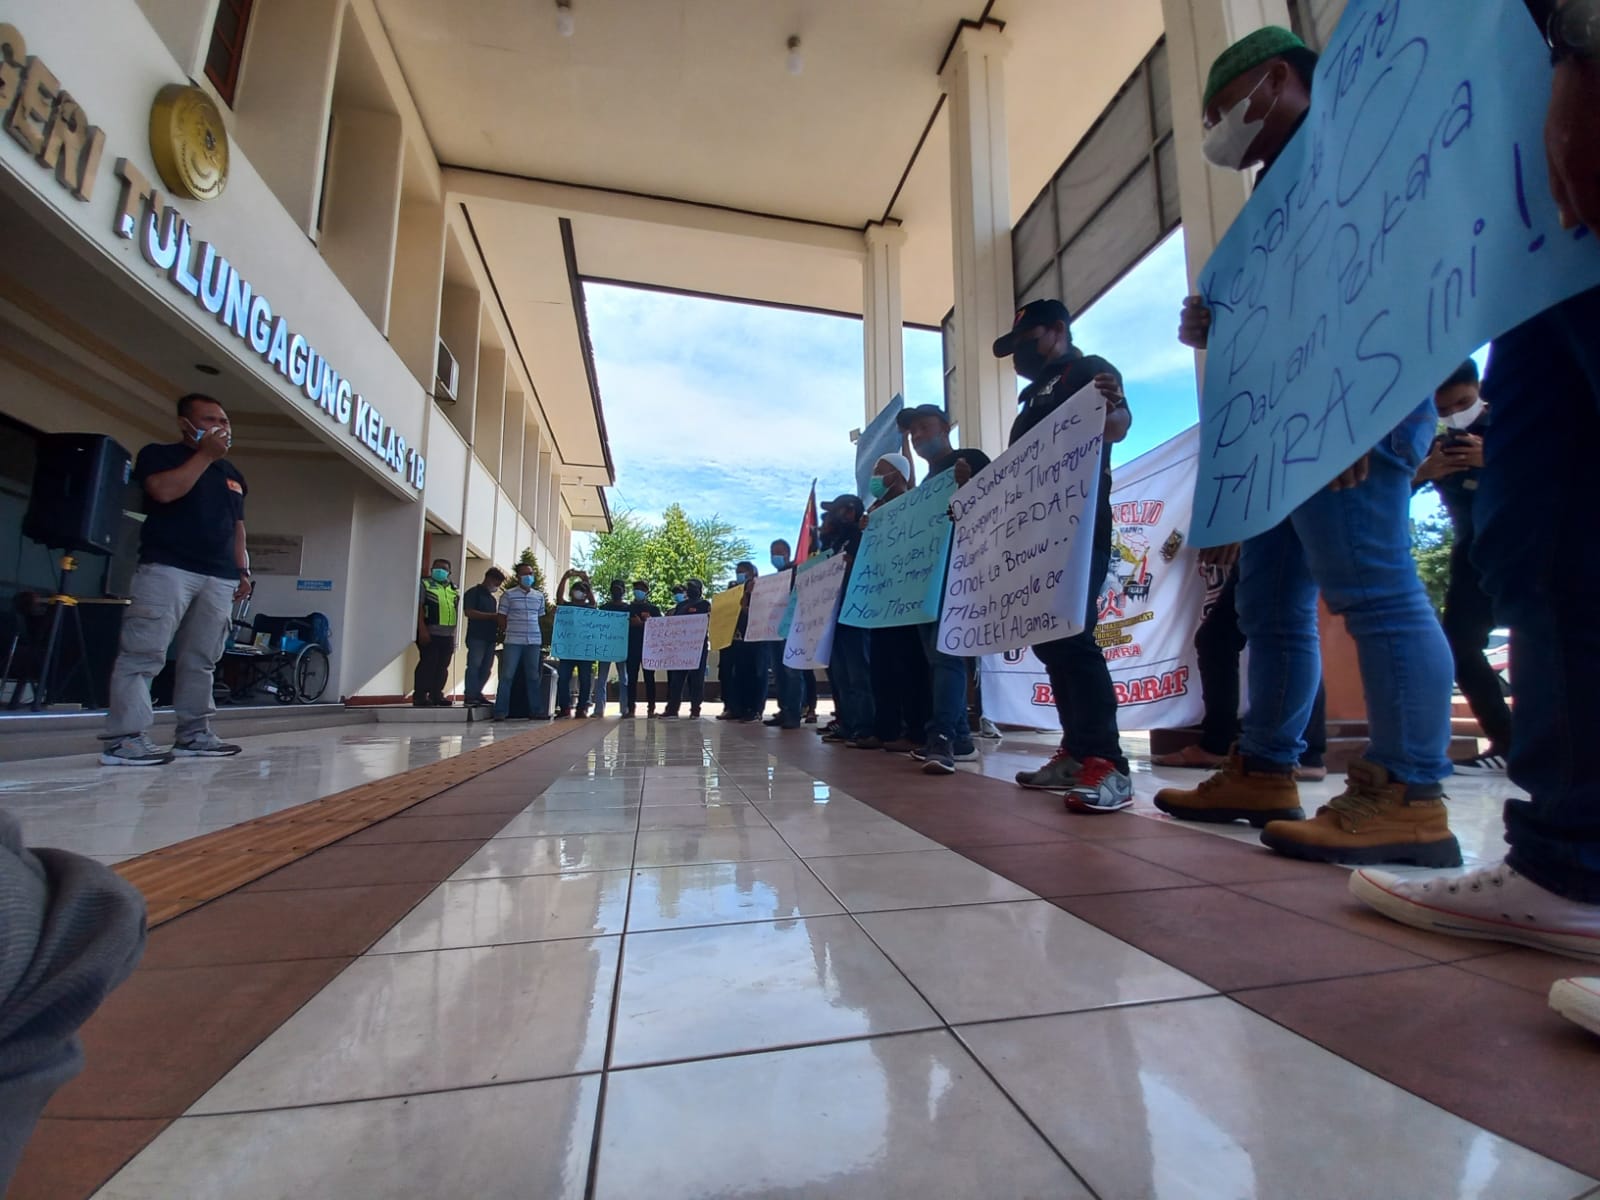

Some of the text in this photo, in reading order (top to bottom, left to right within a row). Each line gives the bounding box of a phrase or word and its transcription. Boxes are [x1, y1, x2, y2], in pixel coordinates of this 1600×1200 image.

[113, 157, 352, 427] TULUNGAGUNG
[350, 394, 406, 473] KELAS
[406, 448, 425, 490] 1B
[1208, 308, 1401, 529] MIRAS
[1112, 665, 1189, 707] BARAT
